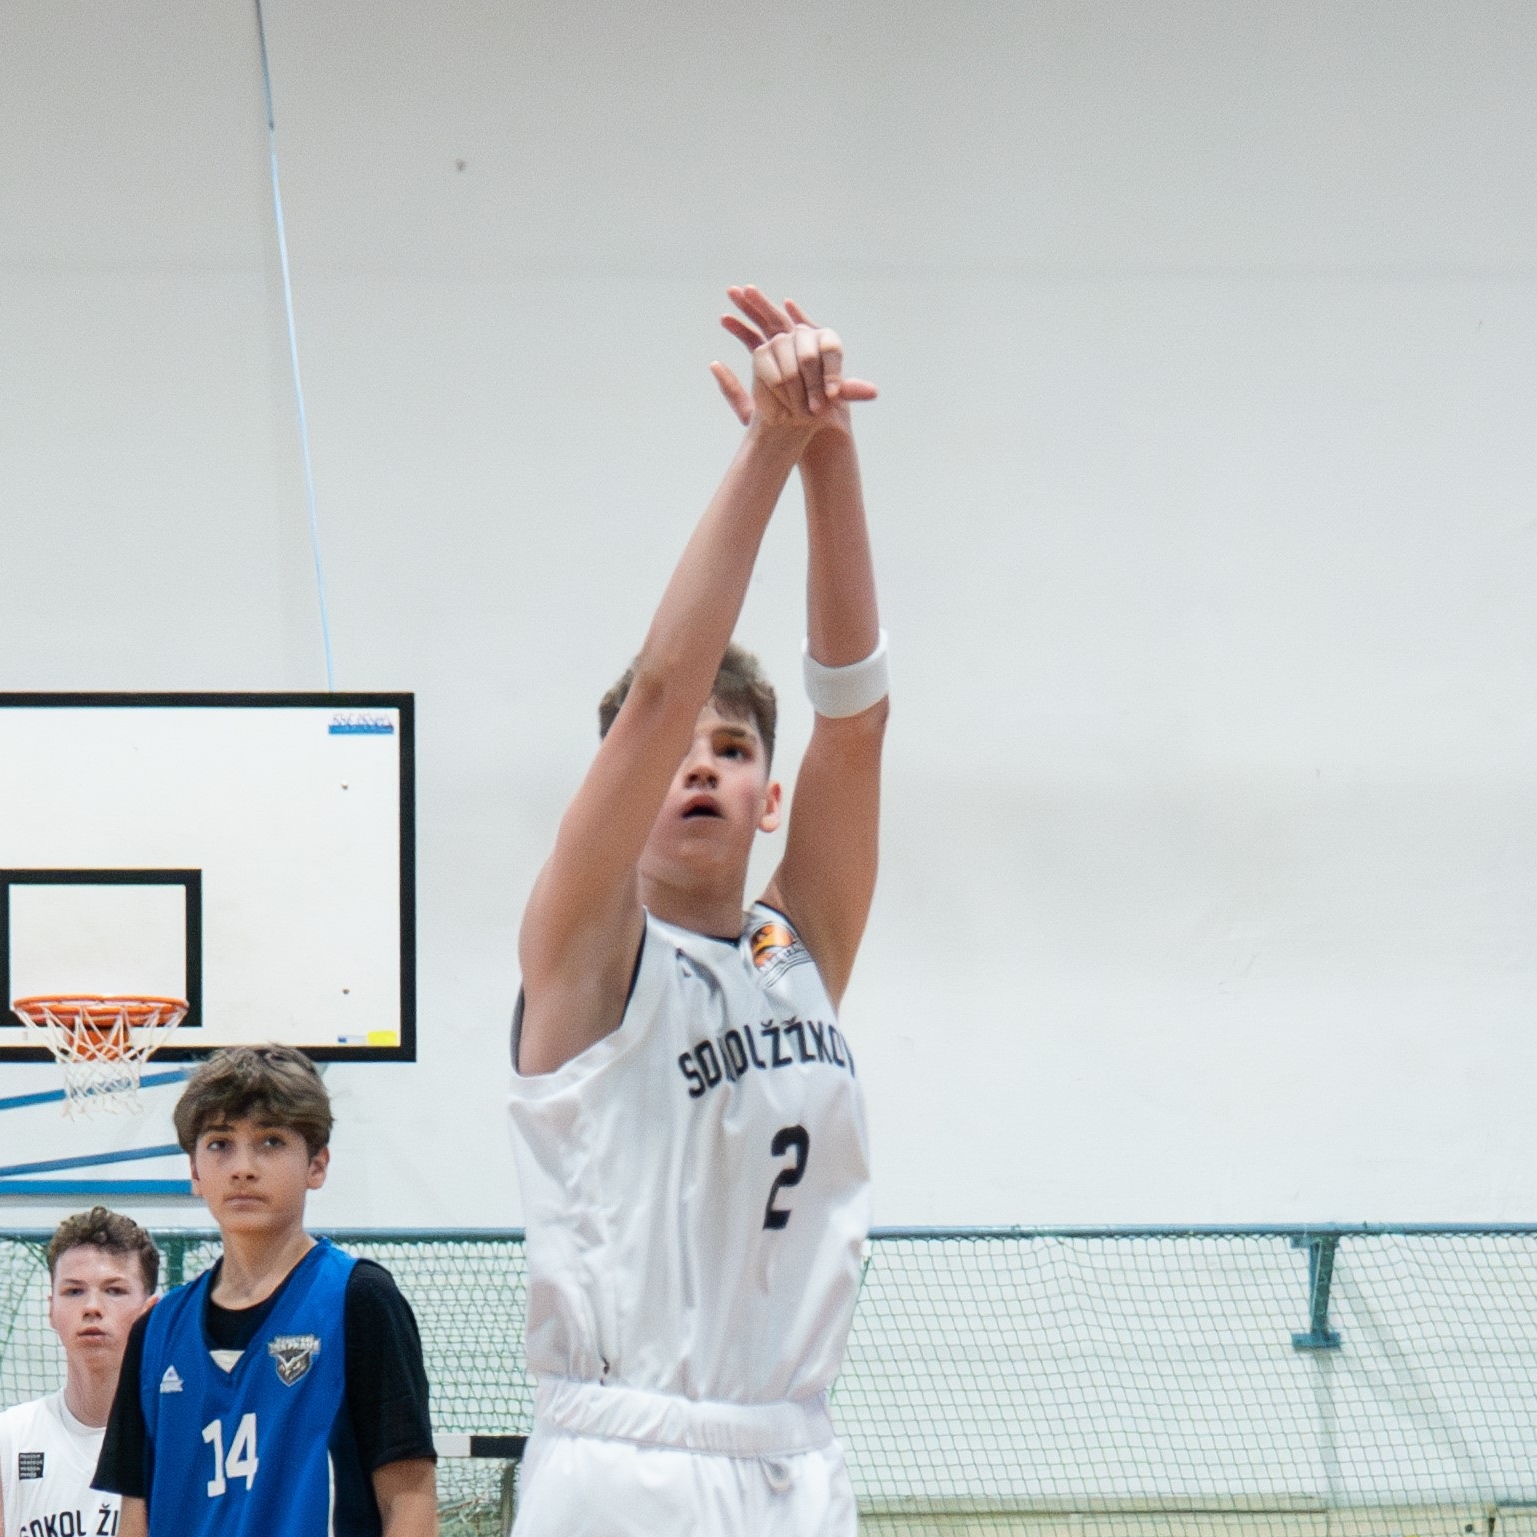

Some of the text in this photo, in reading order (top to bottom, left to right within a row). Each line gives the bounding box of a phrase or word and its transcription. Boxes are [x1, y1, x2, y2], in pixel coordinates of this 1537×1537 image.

[760, 1016, 855, 1078] ŽŽKO
[763, 1124, 810, 1230] 2
[202, 1412, 259, 1498] 14
